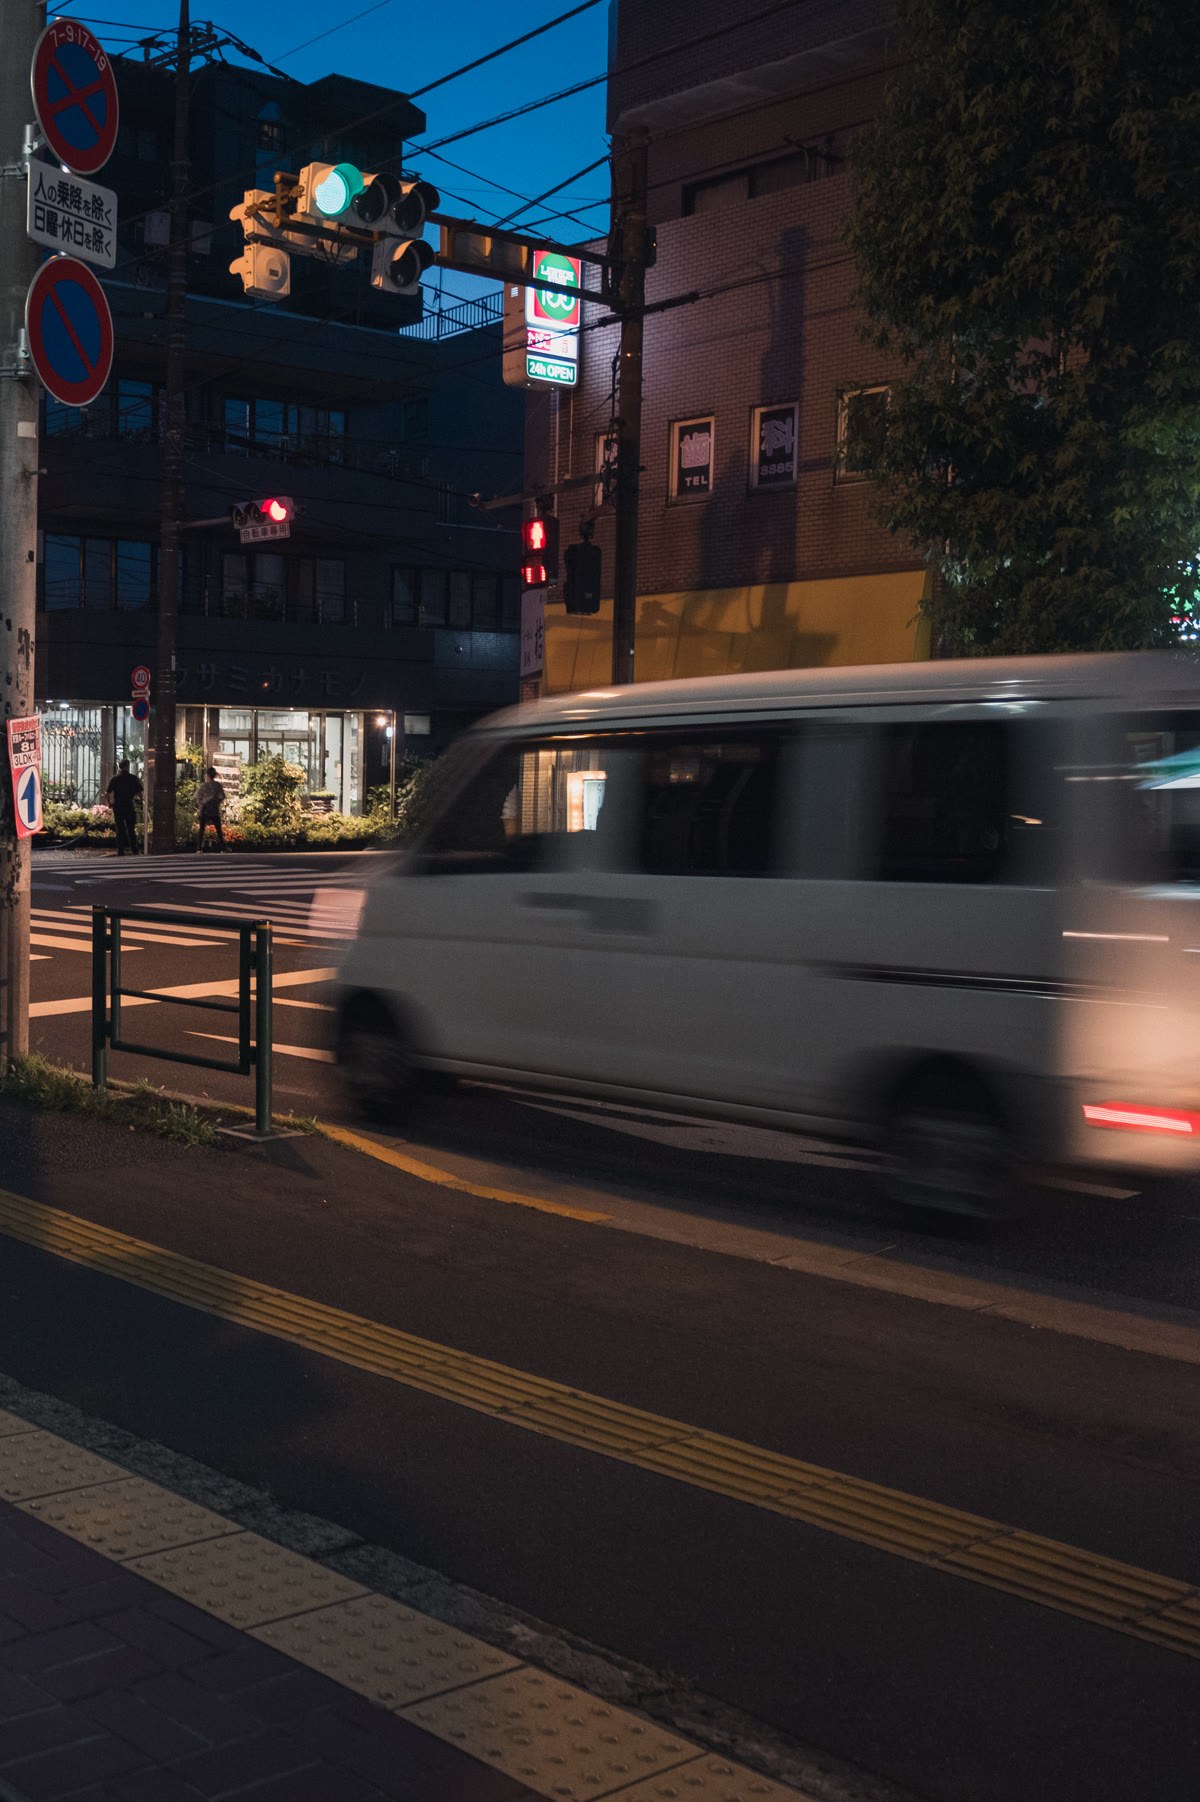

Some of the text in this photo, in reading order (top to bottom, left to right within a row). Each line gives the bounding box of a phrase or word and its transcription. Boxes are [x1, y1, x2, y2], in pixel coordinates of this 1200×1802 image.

[34, 172, 113, 226] 人の乗降を除く
[529, 361, 574, 381] 24h OPEN
[684, 475, 709, 487] TEL
[242, 524, 287, 541] 自転車専用
[136, 672, 147, 683] 40
